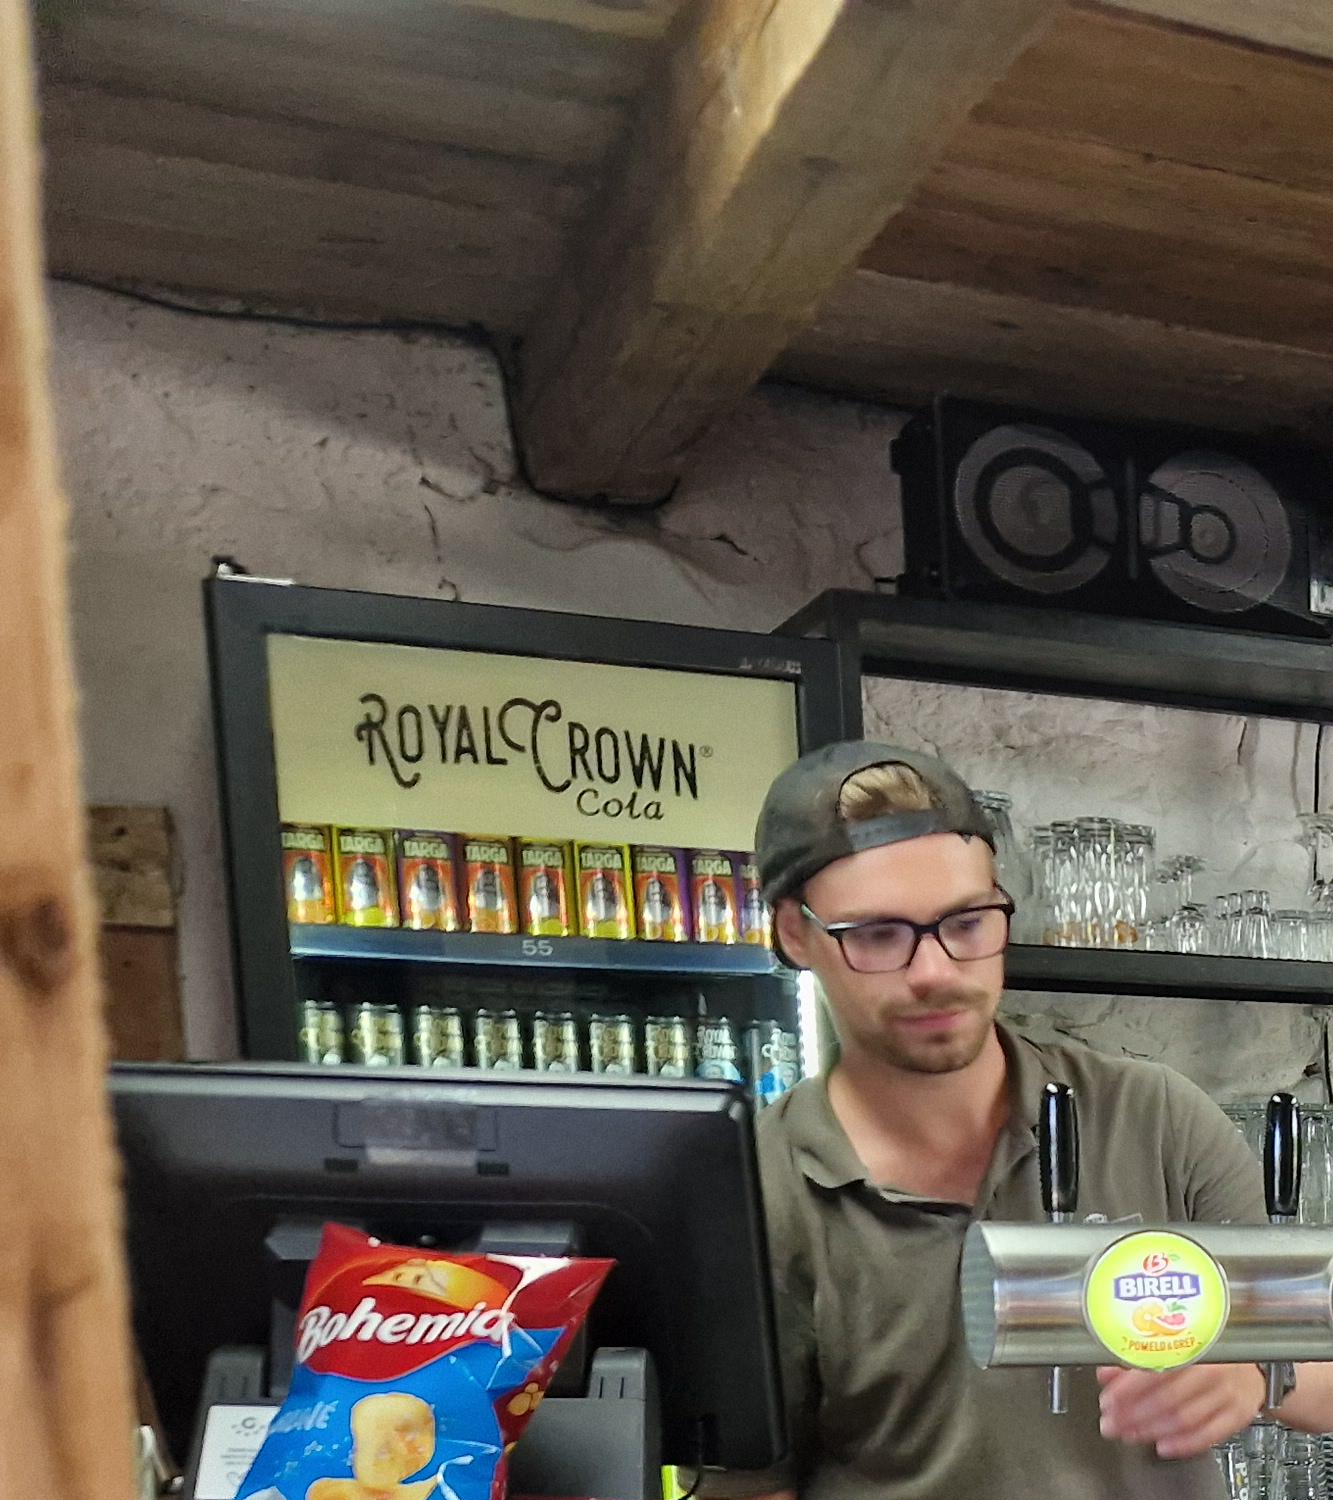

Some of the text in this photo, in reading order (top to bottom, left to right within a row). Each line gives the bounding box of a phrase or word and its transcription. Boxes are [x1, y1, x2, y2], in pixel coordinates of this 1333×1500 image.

[355, 693, 698, 800] ROYAL CROWN
[576, 788, 664, 821] Cola
[522, 939, 554, 955] 55
[1119, 1275, 1196, 1298] BIRELL
[298, 1296, 515, 1364] Bohemia
